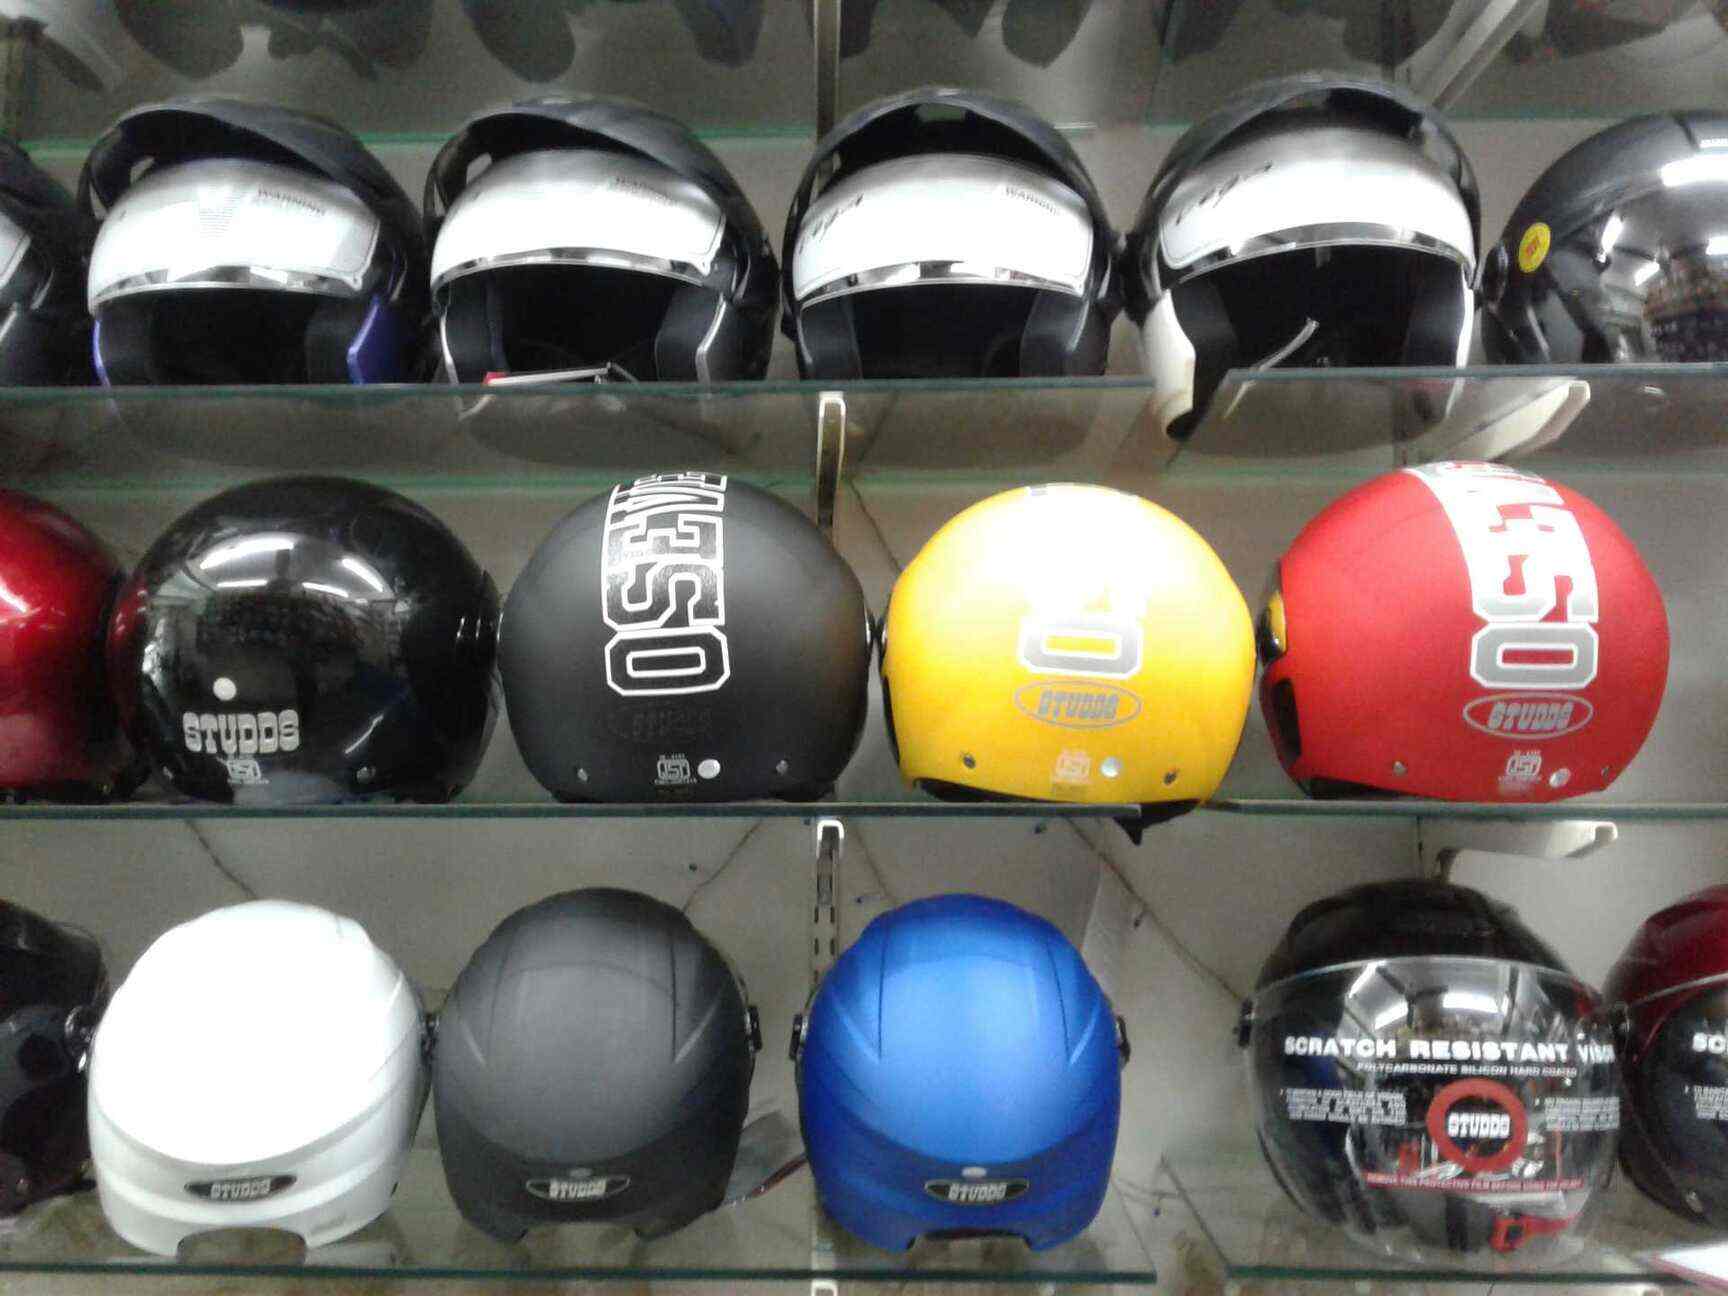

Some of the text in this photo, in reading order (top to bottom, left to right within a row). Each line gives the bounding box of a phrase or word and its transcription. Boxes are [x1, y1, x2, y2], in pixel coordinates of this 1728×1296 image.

[1038, 688, 1120, 720] STUDDS
[1488, 700, 1576, 731] STUDDS
[182, 709, 300, 754] STUDDS
[1284, 1035, 1397, 1058] SCRATCH
[1409, 1039, 1569, 1062] RESISTANT
[1447, 1112, 1511, 1139] STUDDS
[210, 1179, 272, 1200] STUDDS
[548, 1178, 607, 1200] STUDDS
[947, 1183, 1008, 1201] STUDDS
